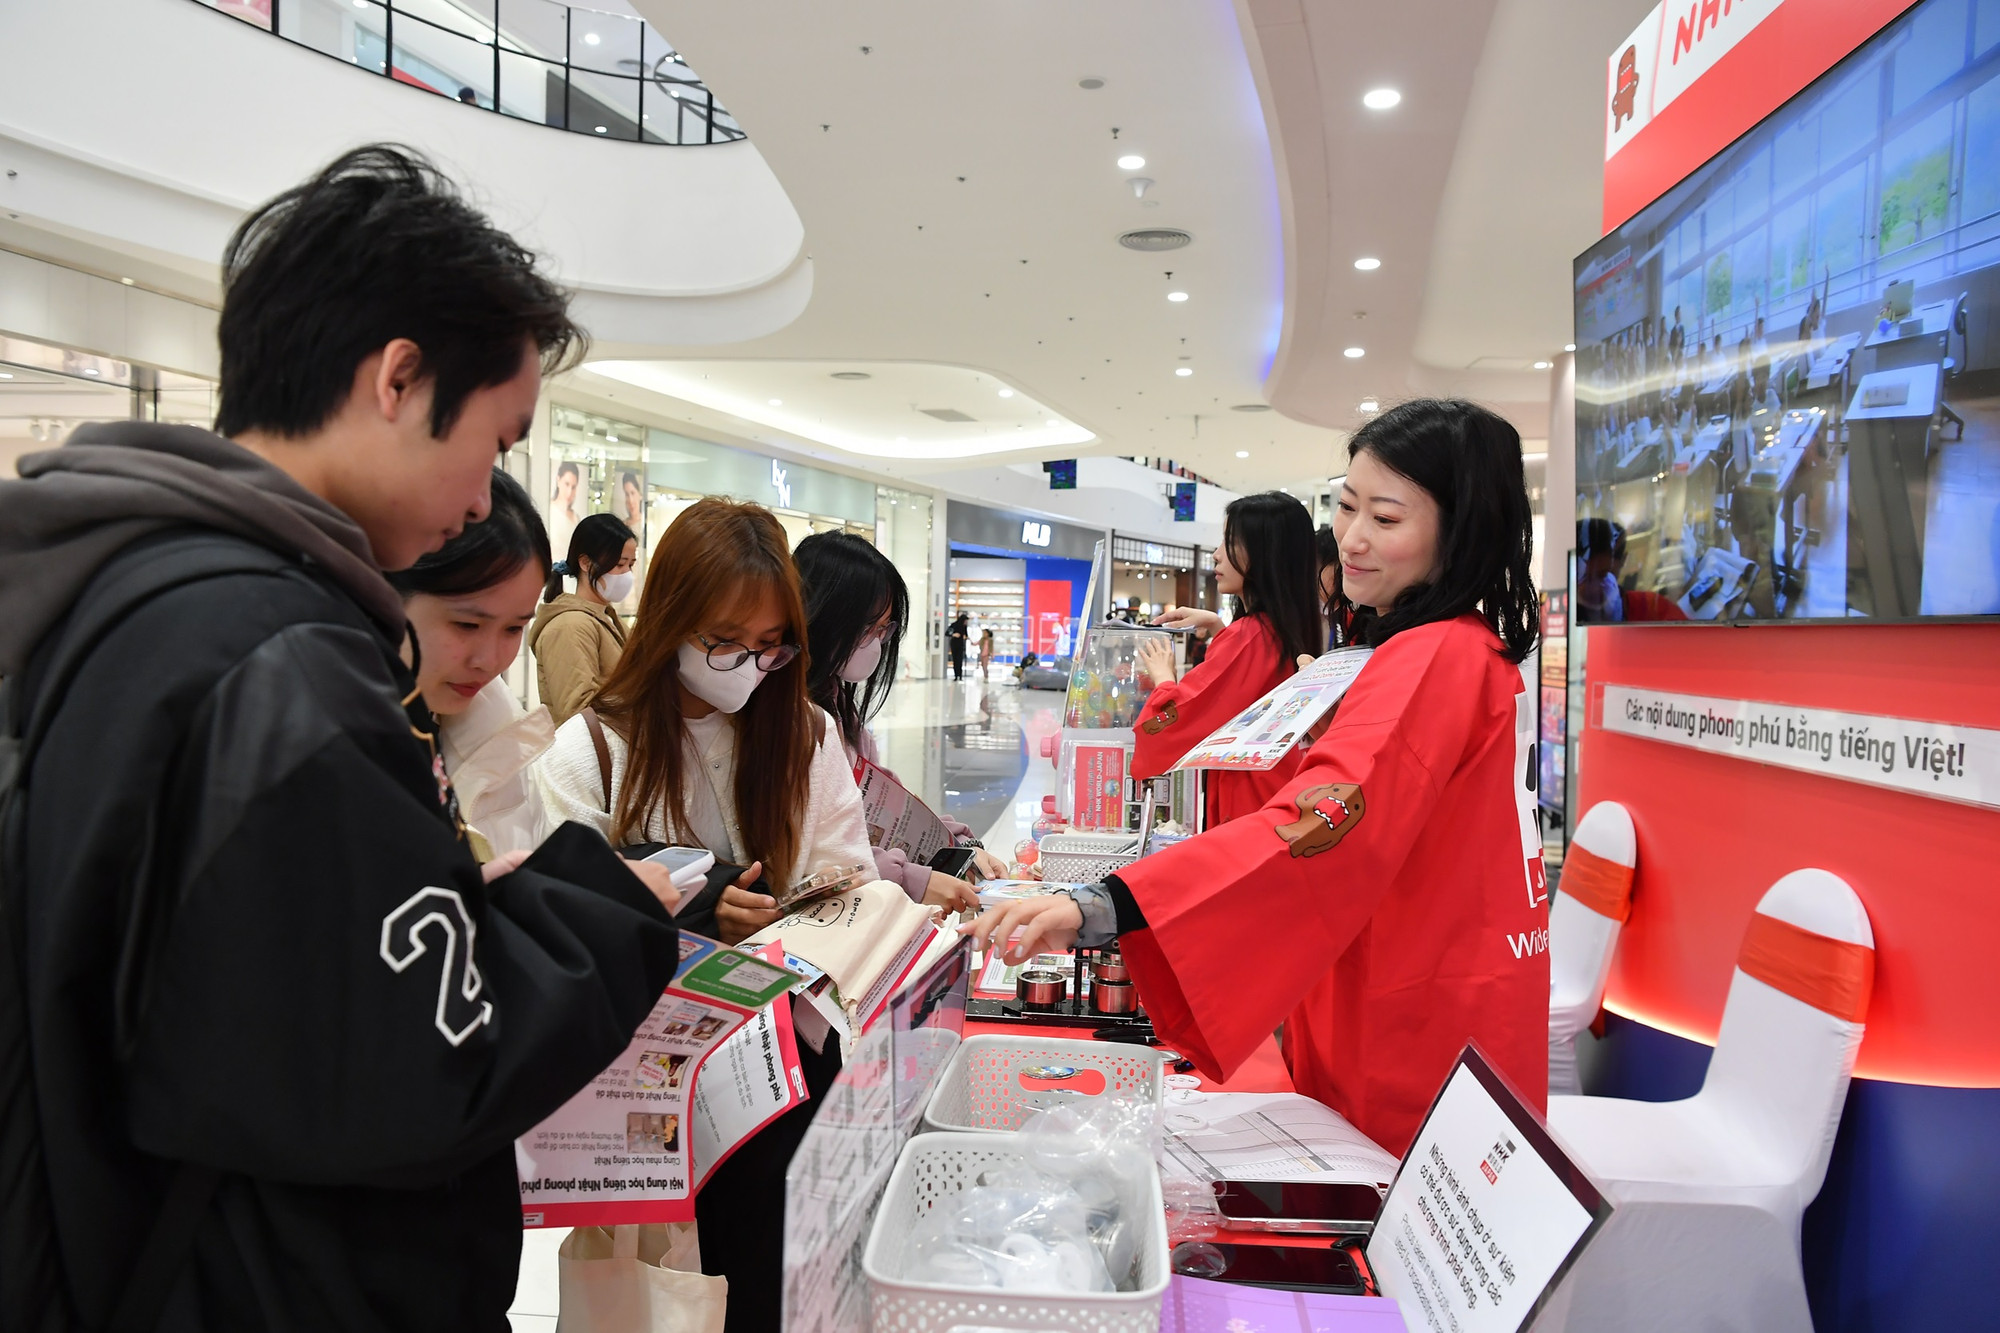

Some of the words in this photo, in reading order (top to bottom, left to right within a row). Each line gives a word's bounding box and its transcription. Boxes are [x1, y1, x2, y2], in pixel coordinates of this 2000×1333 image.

[1021, 521, 1051, 546] MLB
[1625, 698, 1644, 722] Các
[1646, 701, 1663, 731] nội
[1665, 704, 1695, 737] dung
[1699, 709, 1745, 745] phong
[1748, 715, 1780, 750] phú
[1785, 713, 1833, 762] bằng
[1839, 726, 1896, 774] tiếng
[1904, 735, 1966, 781] Việt!
[761, 1030, 770, 1052] Nhật
[763, 1052, 776, 1082] phong
[622, 1090, 635, 1099] lịch
[634, 1091, 645, 1099] du
[645, 1092, 662, 1101] Nhật
[663, 1092, 681, 1102] Tiếng
[770, 1082, 782, 1102] phú
[1492, 1141, 1510, 1164] NHK
[594, 1156, 612, 1165] Nhật
[612, 1156, 630, 1166] tiếng
[630, 1157, 645, 1165] học
[645, 1157, 662, 1165] nhau
[663, 1156, 681, 1166] Cùng
[521, 1178, 541, 1193] phú
[544, 1177, 576, 1191] phong
[578, 1178, 601, 1191] Nhật
[603, 1177, 627, 1192] tiếng
[628, 1178, 645, 1190] học
[646, 1177, 668, 1190] dung
[669, 1178, 684, 1190] Nội
[1429, 1142, 1448, 1178] Những
[1445, 1168, 1460, 1195] hình
[1456, 1186, 1470, 1211] ảnh
[1467, 1207, 1484, 1236] chụp
[1487, 1241, 1503, 1262] sự
[1498, 1254, 1516, 1286] kiện
[1420, 1165, 1431, 1178] có
[1426, 1172, 1440, 1193] thể
[1433, 1187, 1451, 1217] được
[1447, 1213, 1460, 1230] sử
[1455, 1227, 1473, 1260] dụng
[1470, 1250, 1490, 1288] trong
[1486, 1281, 1503, 1306] các
[1417, 1195, 1439, 1237] chương
[1436, 1227, 1451, 1257] trình
[1446, 1252, 1464, 1280] phát
[1460, 1275, 1478, 1310] sóng.
